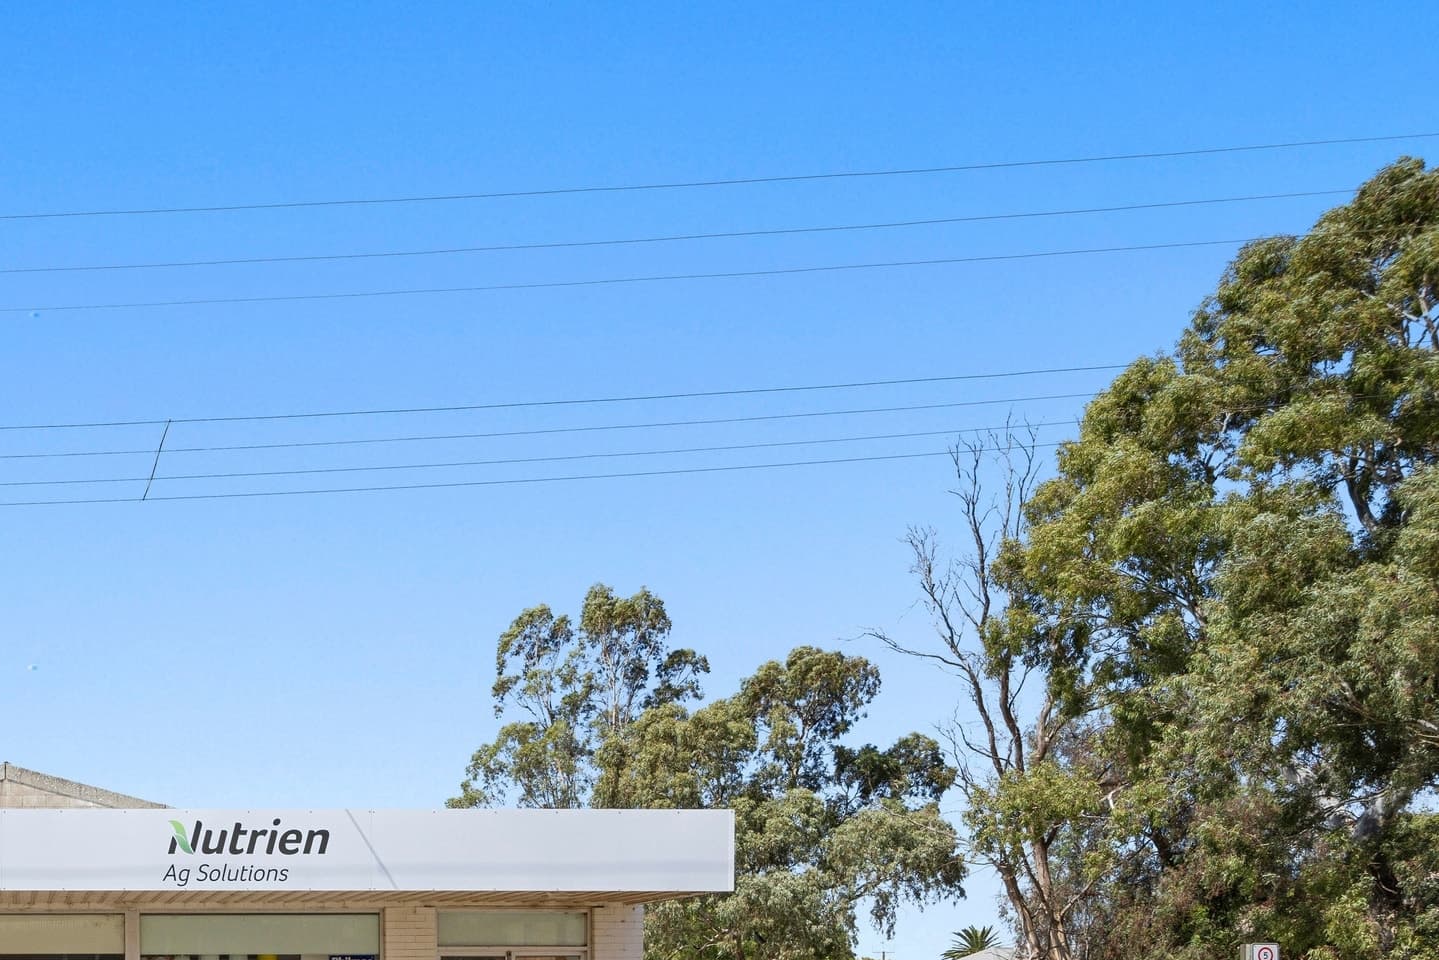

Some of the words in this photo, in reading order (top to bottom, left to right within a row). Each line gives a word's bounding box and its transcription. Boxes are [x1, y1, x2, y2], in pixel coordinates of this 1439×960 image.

[167, 818, 330, 855] Nutrien
[162, 864, 190, 886] Ag
[196, 863, 289, 882] Solutions
